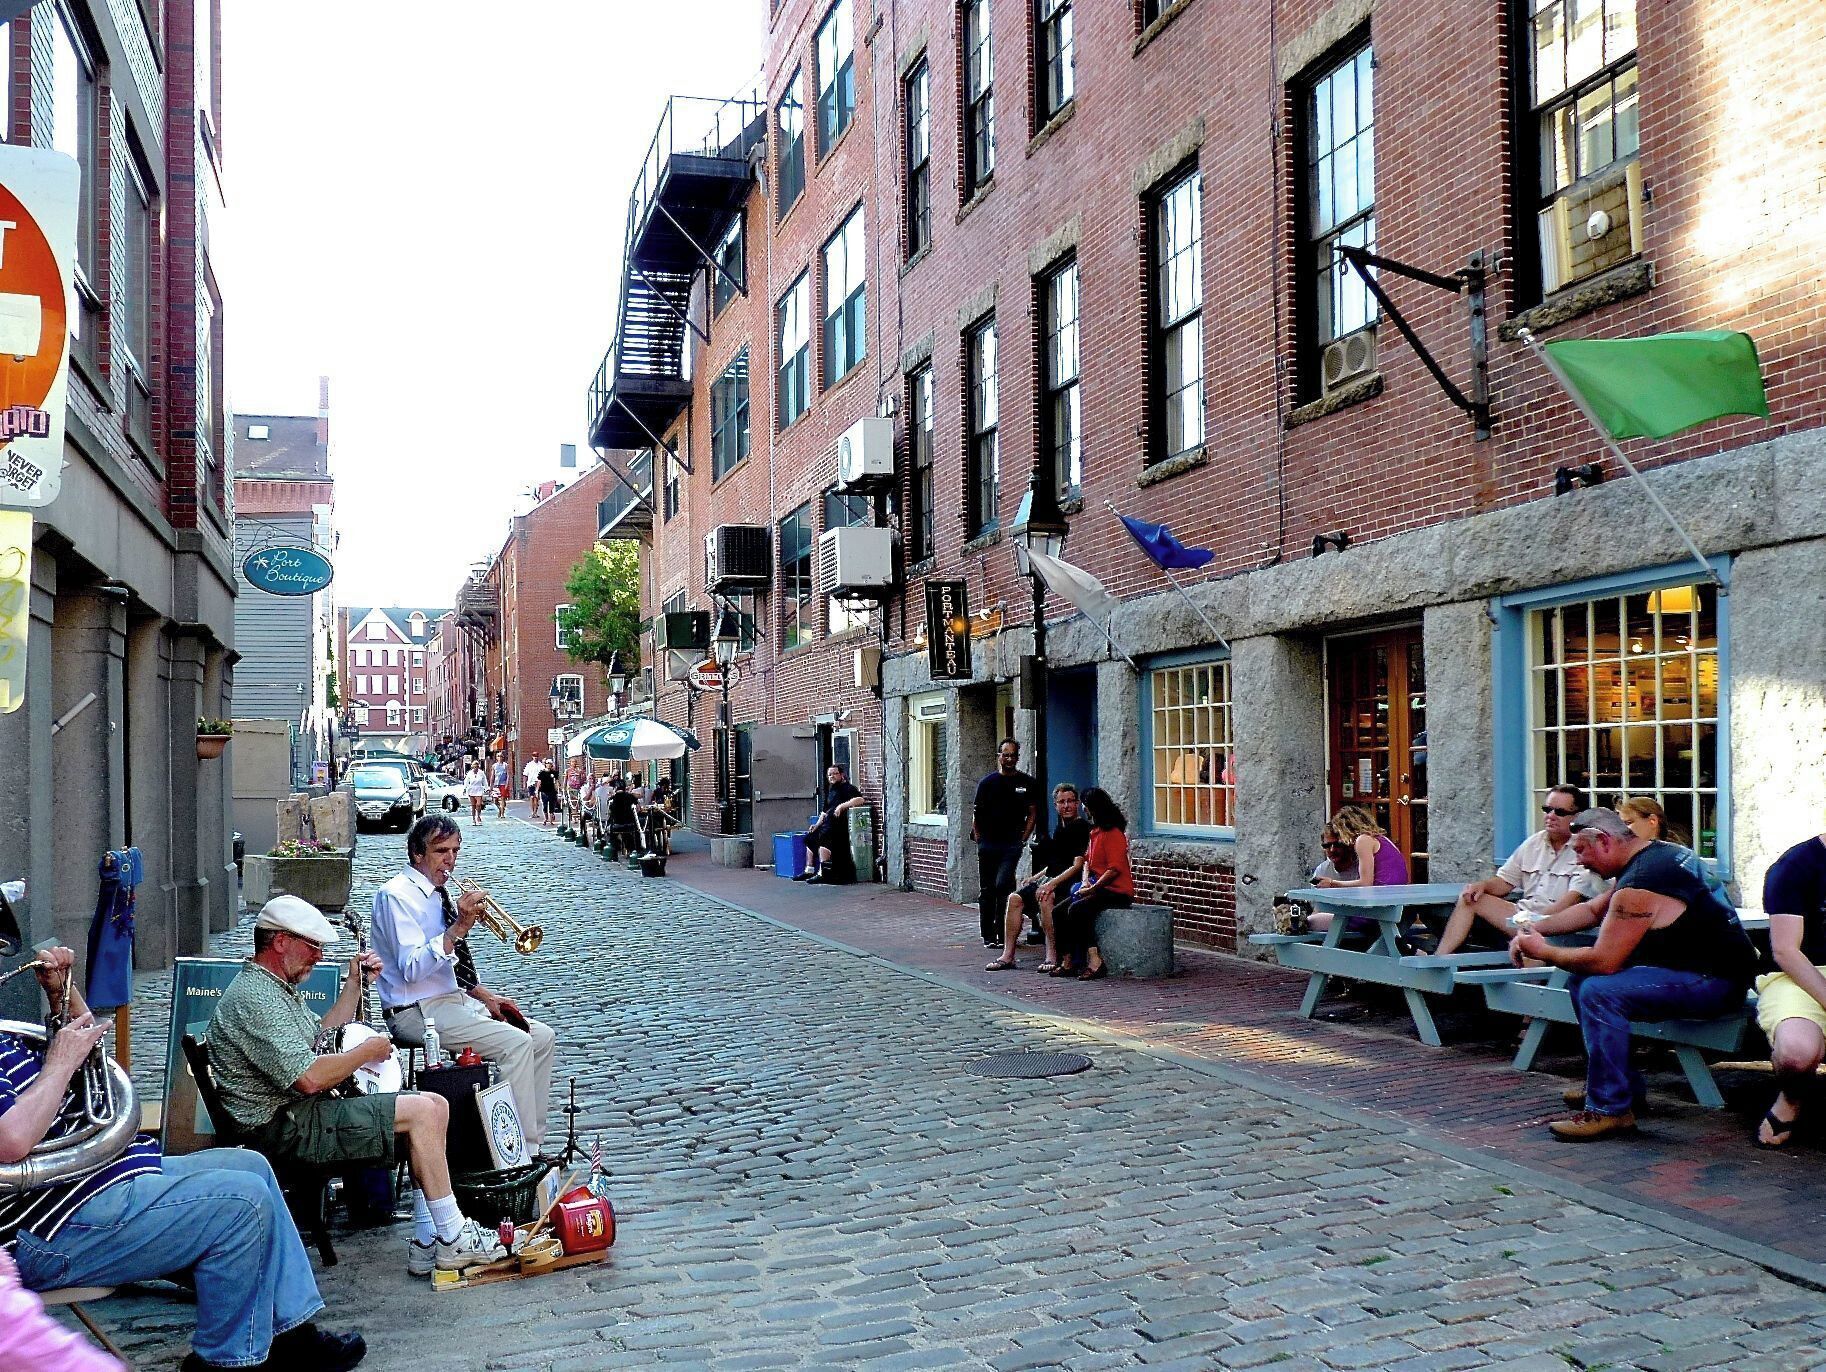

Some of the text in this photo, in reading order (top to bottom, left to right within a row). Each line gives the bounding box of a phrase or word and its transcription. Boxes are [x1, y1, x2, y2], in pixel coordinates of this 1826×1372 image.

[270, 550, 302, 567] Port
[264, 564, 325, 590] Boutique
[941, 586, 957, 675] PORTMANTEAU
[186, 986, 326, 1000] Maine's Shirts
